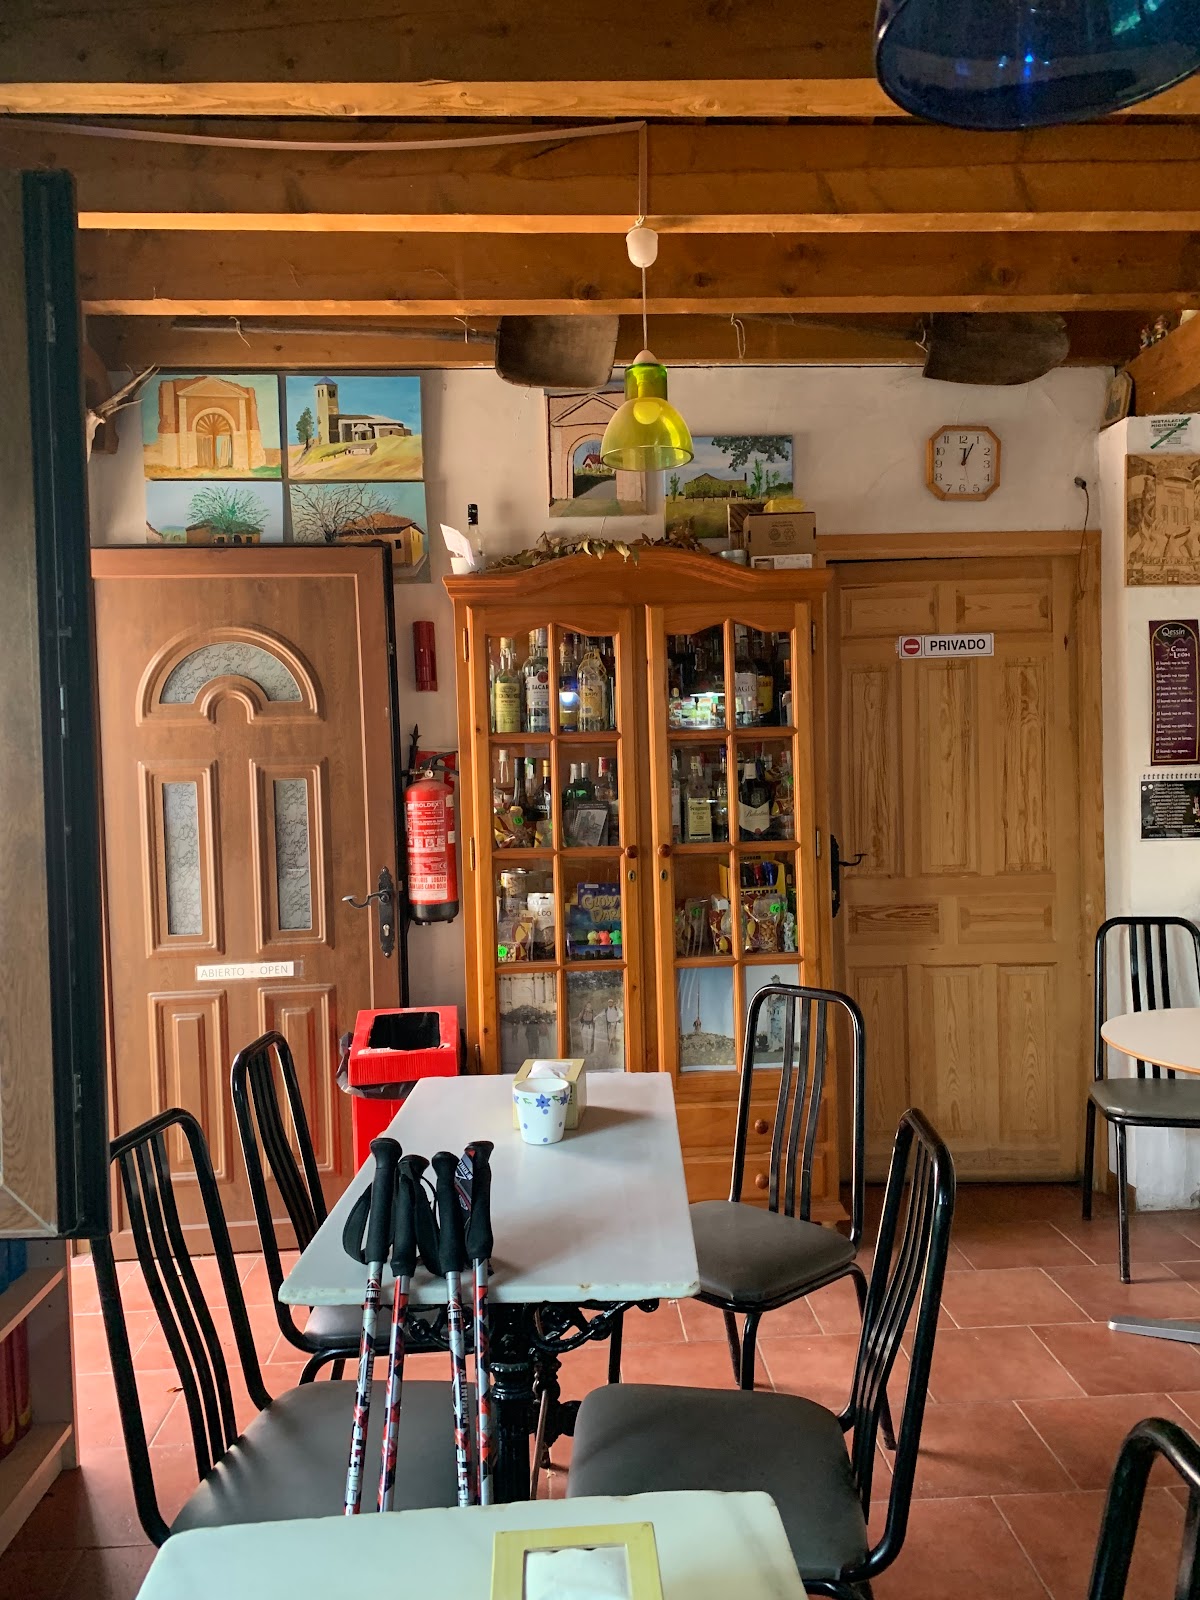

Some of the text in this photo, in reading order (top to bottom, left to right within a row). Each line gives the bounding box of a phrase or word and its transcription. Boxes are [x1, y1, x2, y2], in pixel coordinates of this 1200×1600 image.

[944, 435, 950, 444] 11
[959, 435, 968, 444] 12
[976, 435, 980, 444] 1
[936, 447, 946, 456] 10
[983, 447, 991, 456] 2
[935, 460, 943, 468] 9
[983, 460, 991, 469] 3
[935, 473, 943, 482] 8
[983, 473, 990, 482] 4
[945, 484, 952, 492] 7
[959, 484, 966, 493] 6
[972, 484, 980, 493] 5
[930, 638, 986, 651] PRIVADO
[200, 967, 245, 978] ABIERTO
[260, 965, 288, 975] OPEN
